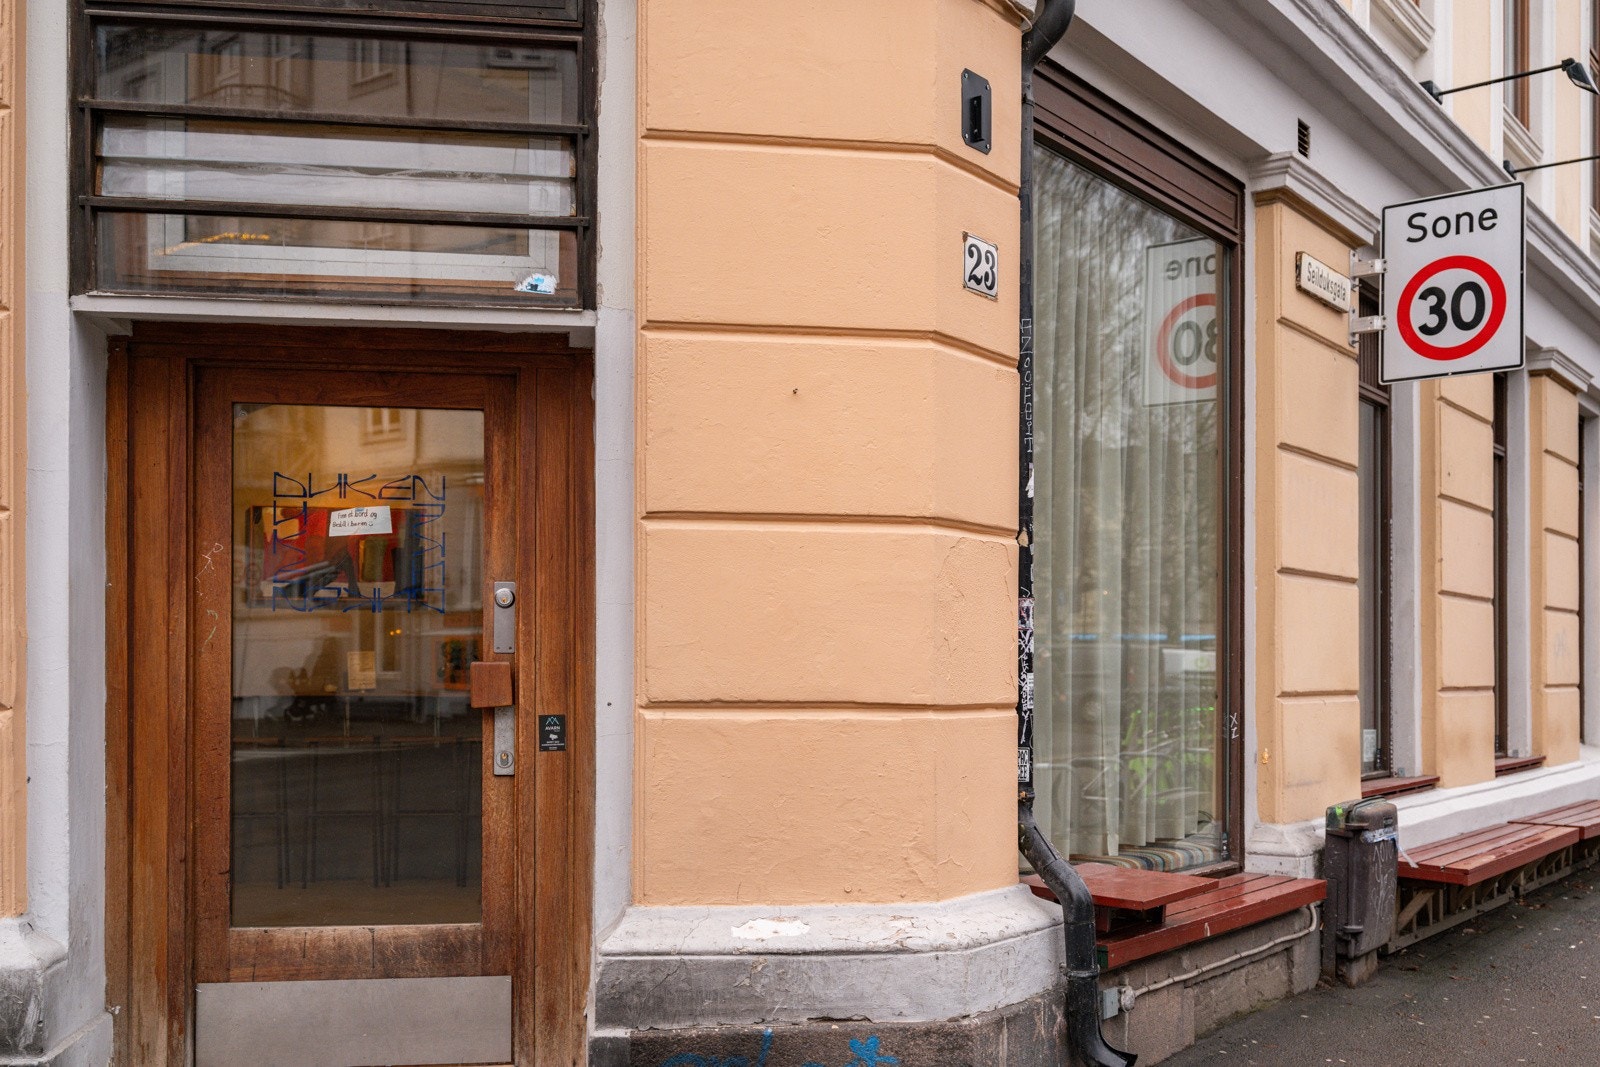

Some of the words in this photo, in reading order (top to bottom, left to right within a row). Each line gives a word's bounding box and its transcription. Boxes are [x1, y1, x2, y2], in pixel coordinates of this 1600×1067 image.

[1406, 207, 1498, 243] Sone
[967, 243, 996, 291] 23
[1306, 261, 1347, 302] Seilduksgata
[1418, 281, 1486, 336] 30
[354, 508, 369, 518] bord
[370, 511, 378, 520] og
